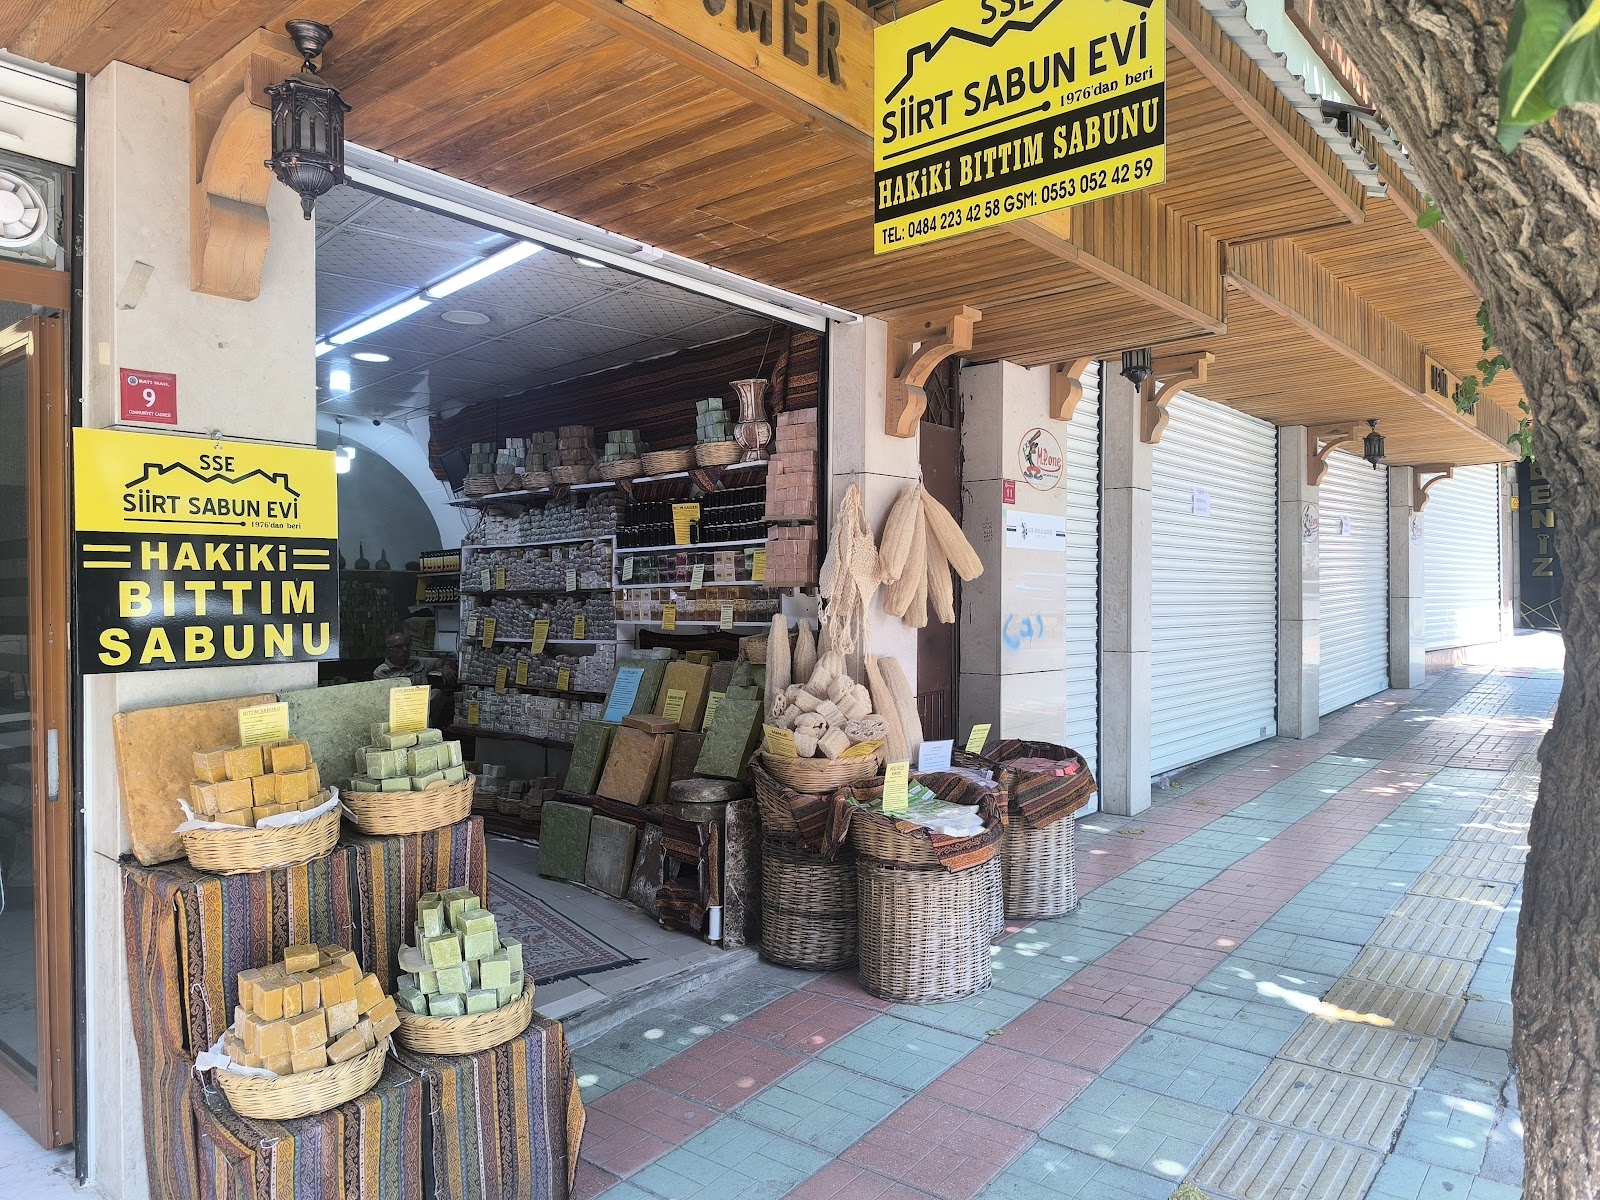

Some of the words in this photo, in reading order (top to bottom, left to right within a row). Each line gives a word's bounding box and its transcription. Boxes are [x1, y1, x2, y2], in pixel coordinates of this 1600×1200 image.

[963, 46, 1075, 117] SABUN
[1089, 11, 1147, 76] EVİ
[1059, 79, 1119, 107] 1976'dan
[1125, 65, 1153, 87] beri
[959, 131, 1044, 187] BITTIM
[1053, 97, 1159, 160] SABUNU
[882, 226, 905, 245] TEL:
[908, 217, 937, 239] 0484
[940, 210, 962, 230] 223
[965, 204, 981, 223] 42
[984, 199, 1001, 219] 58
[1003, 189, 1038, 213] GSM:
[1041, 178, 1076, 204] 0553
[1079, 170, 1107, 194] 052
[1111, 163, 1130, 186] 42
[1133, 157, 1154, 179] 59
[142, 388, 156, 408] 9
[199, 454, 235, 473] SSE
[188, 496, 260, 518] SABUN
[267, 497, 299, 519] EVİ
[250, 521, 284, 529] 1976'dan
[286, 522, 302, 530] beri
[118, 580, 315, 618] BITTIM
[98, 621, 331, 667] SABUNU
